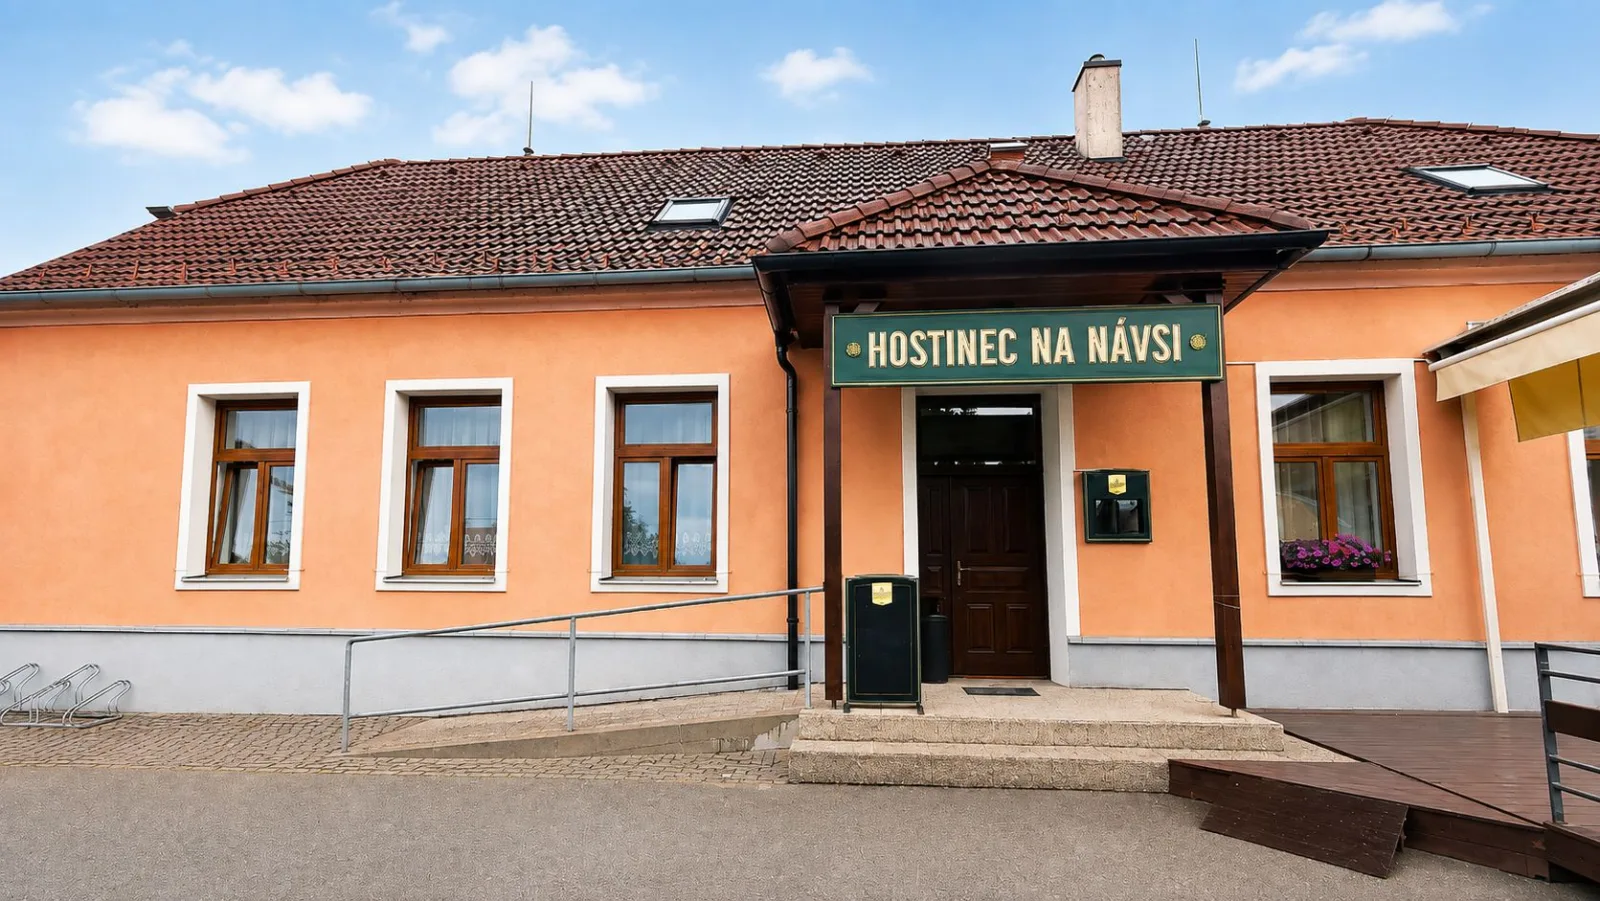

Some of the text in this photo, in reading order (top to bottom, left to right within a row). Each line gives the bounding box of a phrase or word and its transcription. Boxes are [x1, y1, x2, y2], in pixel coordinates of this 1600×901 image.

[868, 317, 1182, 367] HOSTINEC NA NÁVSI
